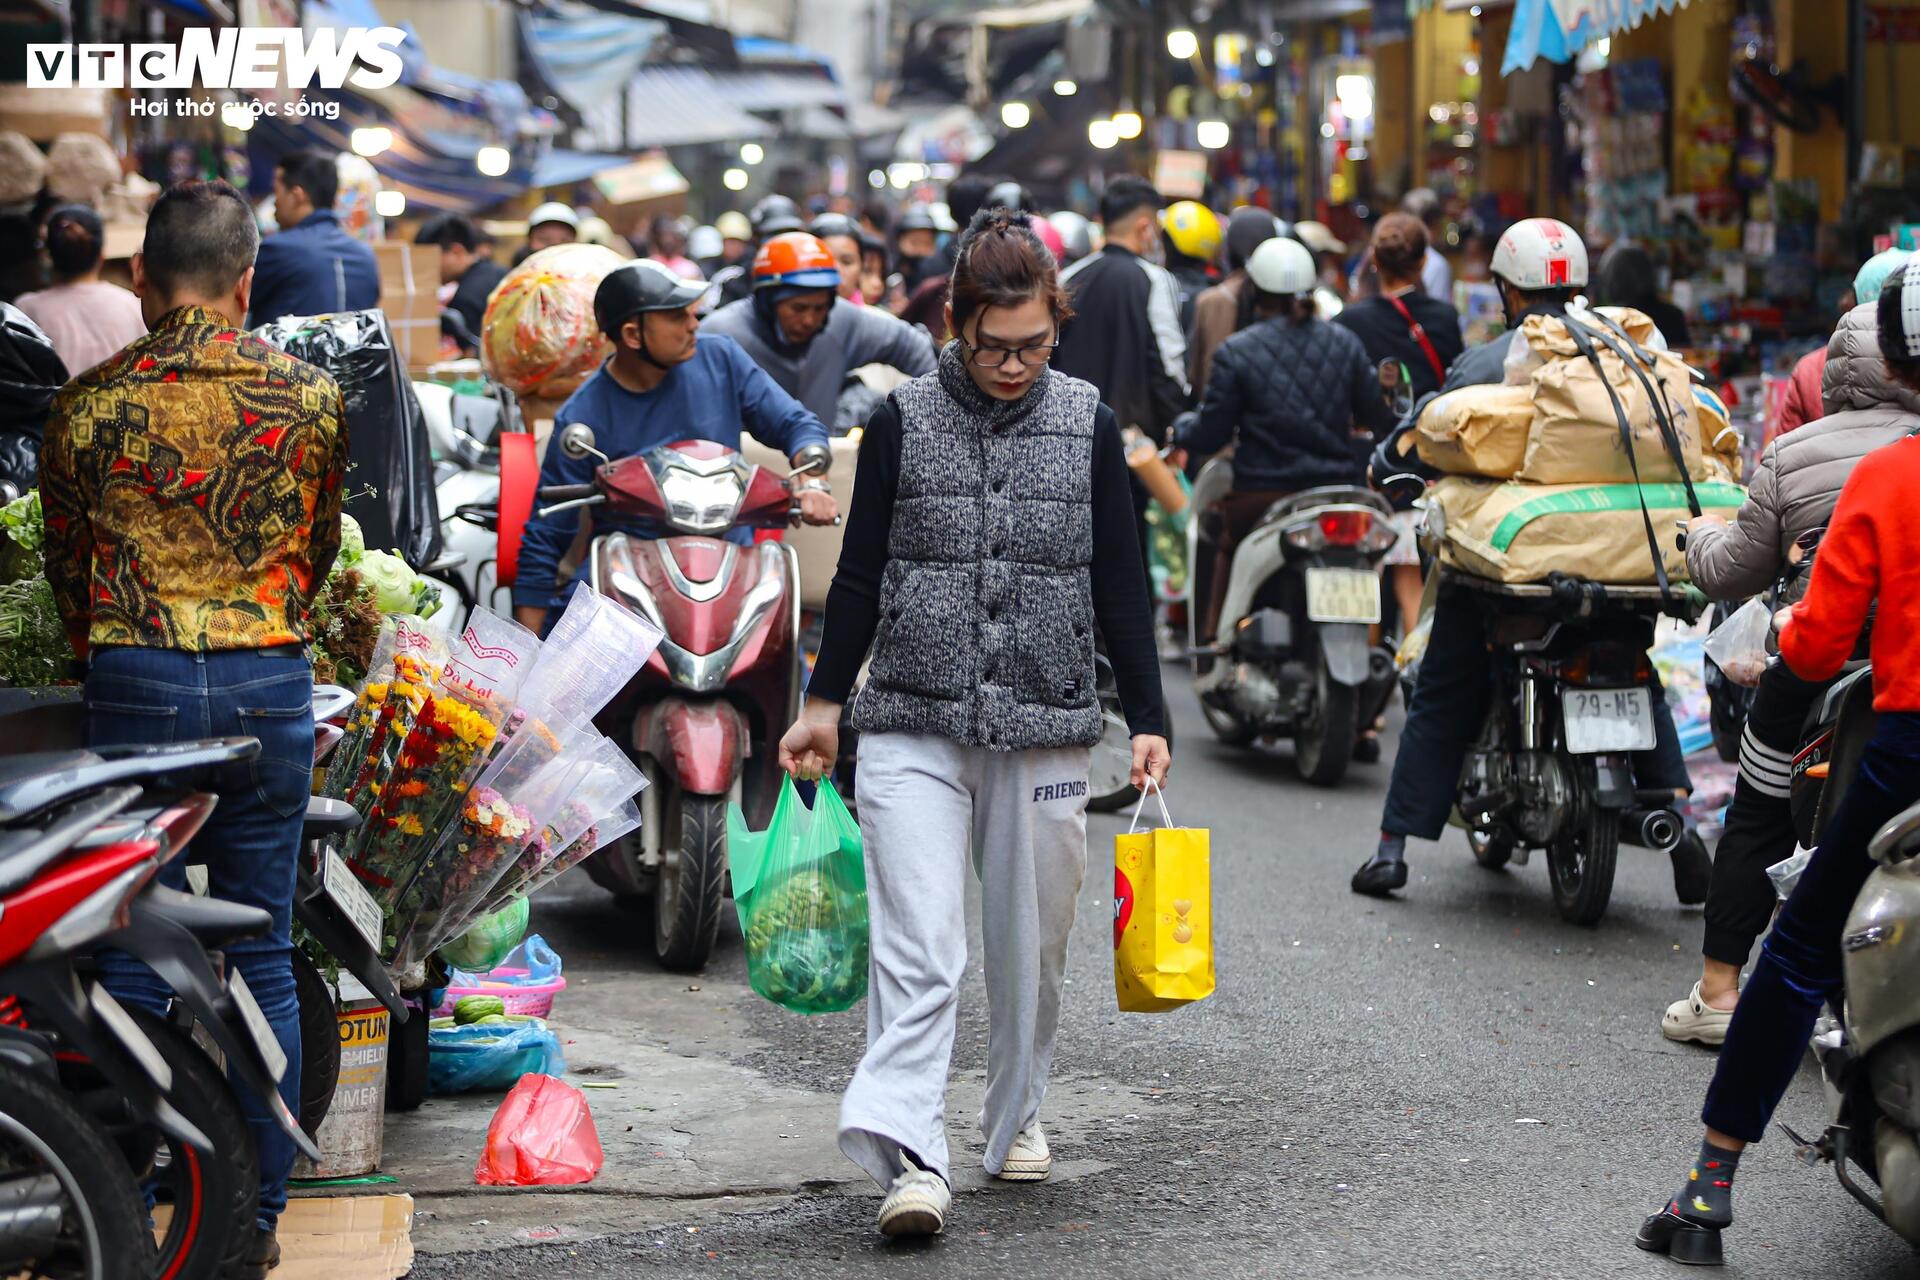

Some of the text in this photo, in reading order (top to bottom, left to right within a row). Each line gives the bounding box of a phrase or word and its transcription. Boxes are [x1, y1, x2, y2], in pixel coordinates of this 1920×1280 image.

[1033, 780, 1087, 802] FRIENDS
[338, 1016, 387, 1042] OTUN
[341, 1046, 385, 1066] SHIELD
[331, 1087, 378, 1108] IMER
